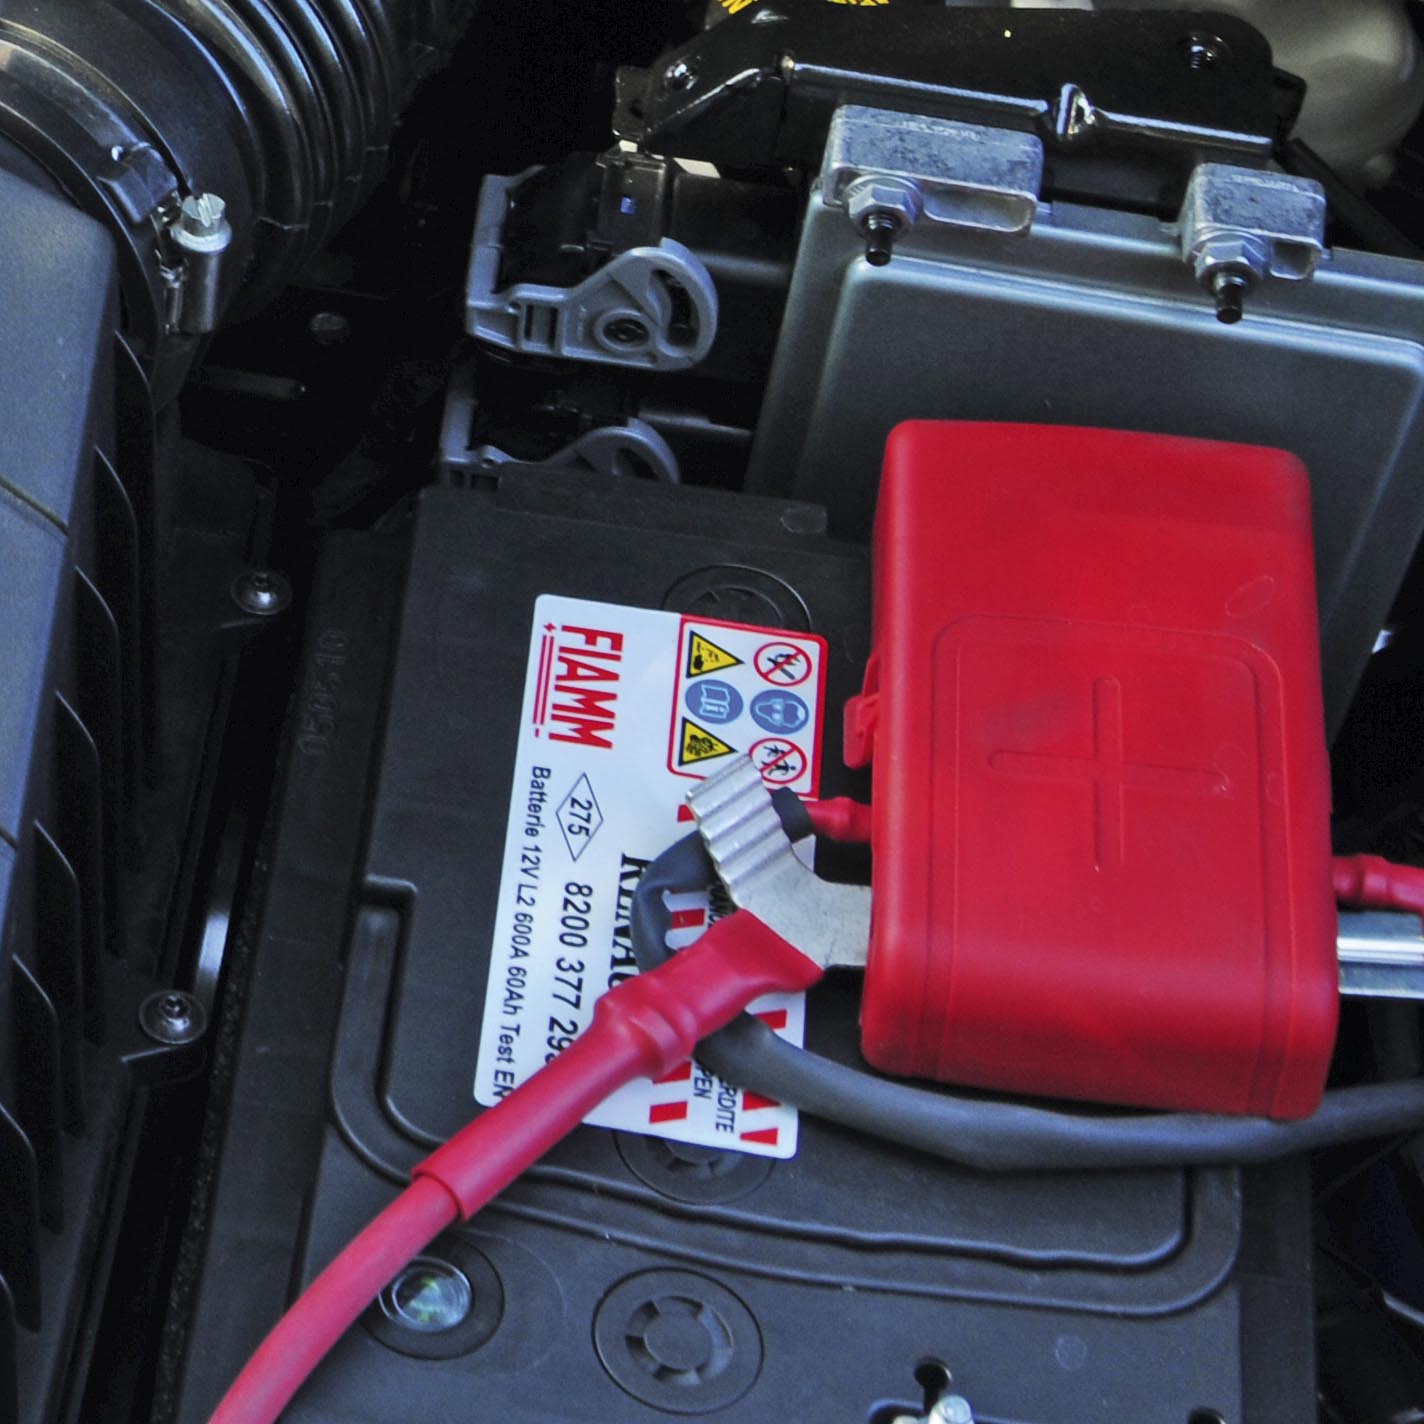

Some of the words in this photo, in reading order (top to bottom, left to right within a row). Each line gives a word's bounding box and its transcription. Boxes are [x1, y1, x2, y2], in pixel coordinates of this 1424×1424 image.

[548, 624, 623, 749] FIAMM
[524, 765, 552, 837] Batterie
[567, 797, 593, 837] 275
[520, 845, 543, 880] 12V
[516, 883, 538, 907] L2
[559, 881, 593, 948] 8200
[509, 912, 534, 959] 600A
[502, 965, 528, 1015] 60Ah
[552, 957, 586, 1010] 377
[496, 1023, 521, 1064] Test
